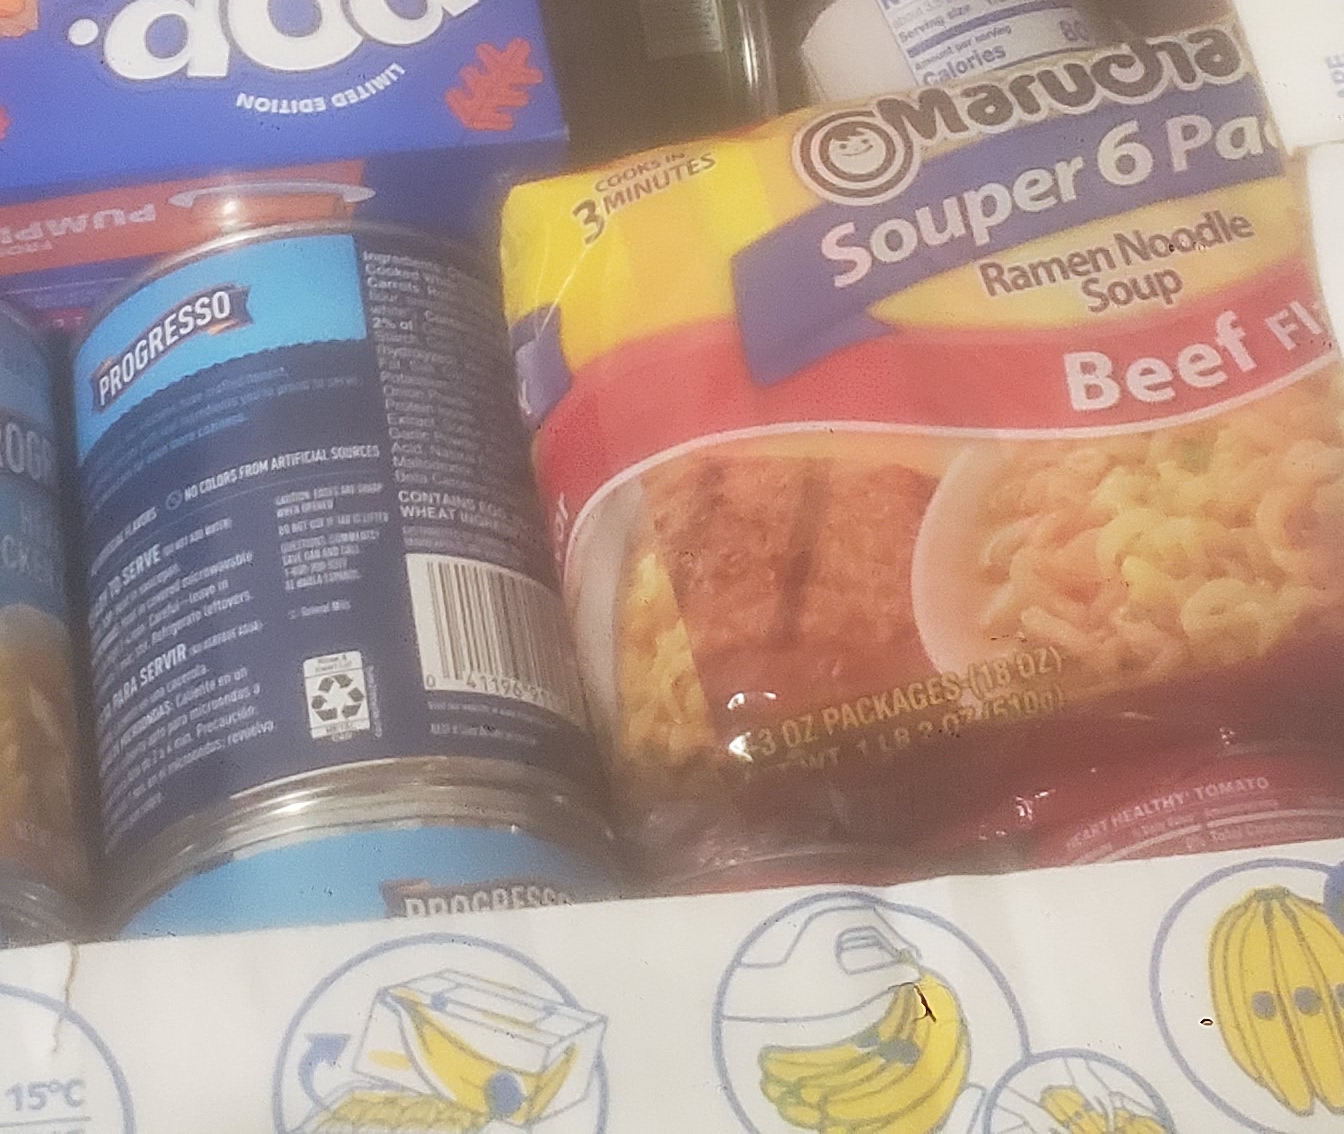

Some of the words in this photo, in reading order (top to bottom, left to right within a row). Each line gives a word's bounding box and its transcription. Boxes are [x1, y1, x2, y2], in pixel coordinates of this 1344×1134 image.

[329, 62, 406, 109] LIMITED
[922, 44, 1006, 87] Calories
[236, 88, 326, 114] EDITION
[594, 157, 661, 191] COOKS
[664, 150, 688, 167] IN
[571, 199, 609, 247] 3
[600, 151, 716, 217] MINUTES
[821, 155, 1084, 289] Souper
[1097, 122, 1156, 188] 6
[980, 242, 1114, 298] Ramen
[1122, 209, 1256, 268] Noodle
[1083, 268, 1185, 313] Soup
[98, 288, 233, 407] PROGRESSO
[1061, 310, 1260, 413] Beef
[237, 458, 268, 481] FROM
[269, 447, 329, 474] ARTIFICIAL
[397, 486, 476, 515] CONTAINS
[398, 500, 456, 526] WHEAT
[121, 543, 161, 587] SERVE
[139, 642, 187, 687] SERVIR
[425, 673, 437, 689] 0
[781, 715, 816, 750] OZ
[821, 670, 964, 736] PACKAGES
[1192, 776, 1270, 801] TOMATO
